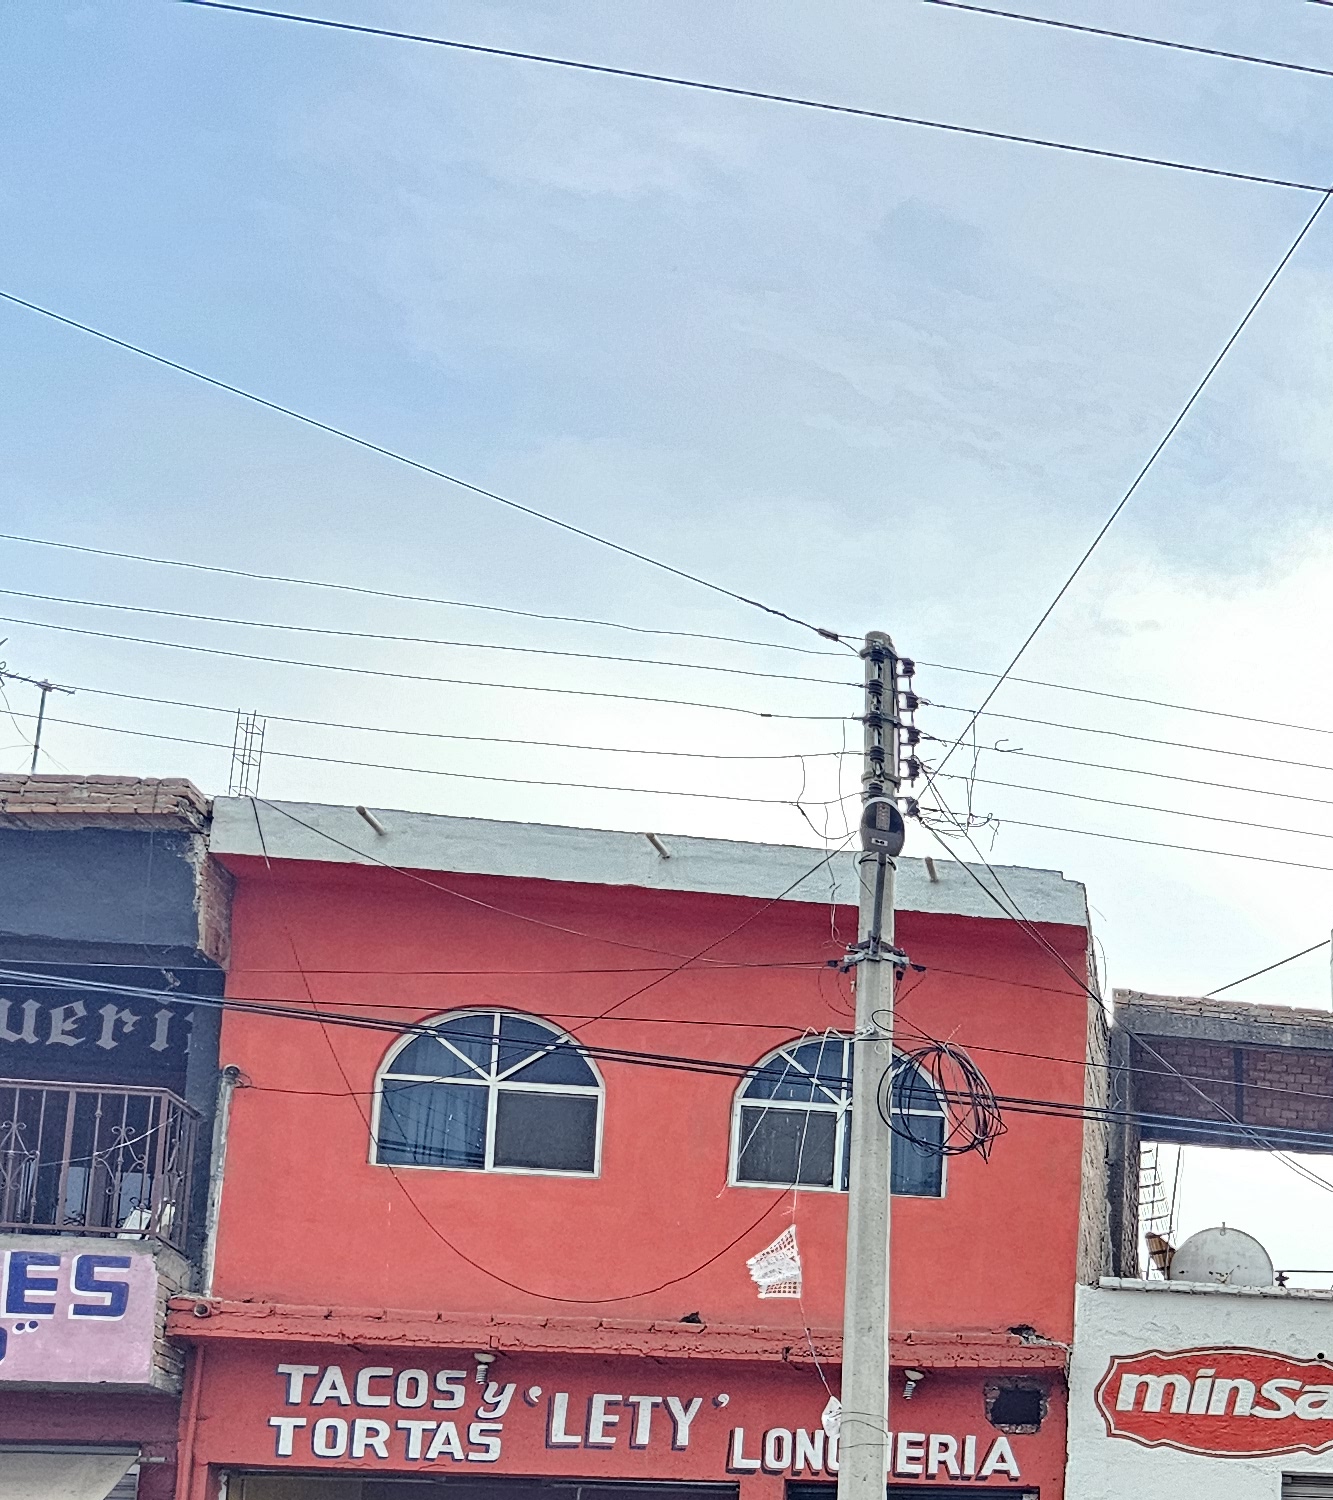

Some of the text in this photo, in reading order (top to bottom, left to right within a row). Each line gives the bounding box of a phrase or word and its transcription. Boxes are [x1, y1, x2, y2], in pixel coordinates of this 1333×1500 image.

[0, 995, 194, 1053] ueri
[277, 1363, 517, 1419] TACOS y
[268, 1417, 503, 1463] TORTAS
[727, 1427, 1021, 1481] LONERIA
